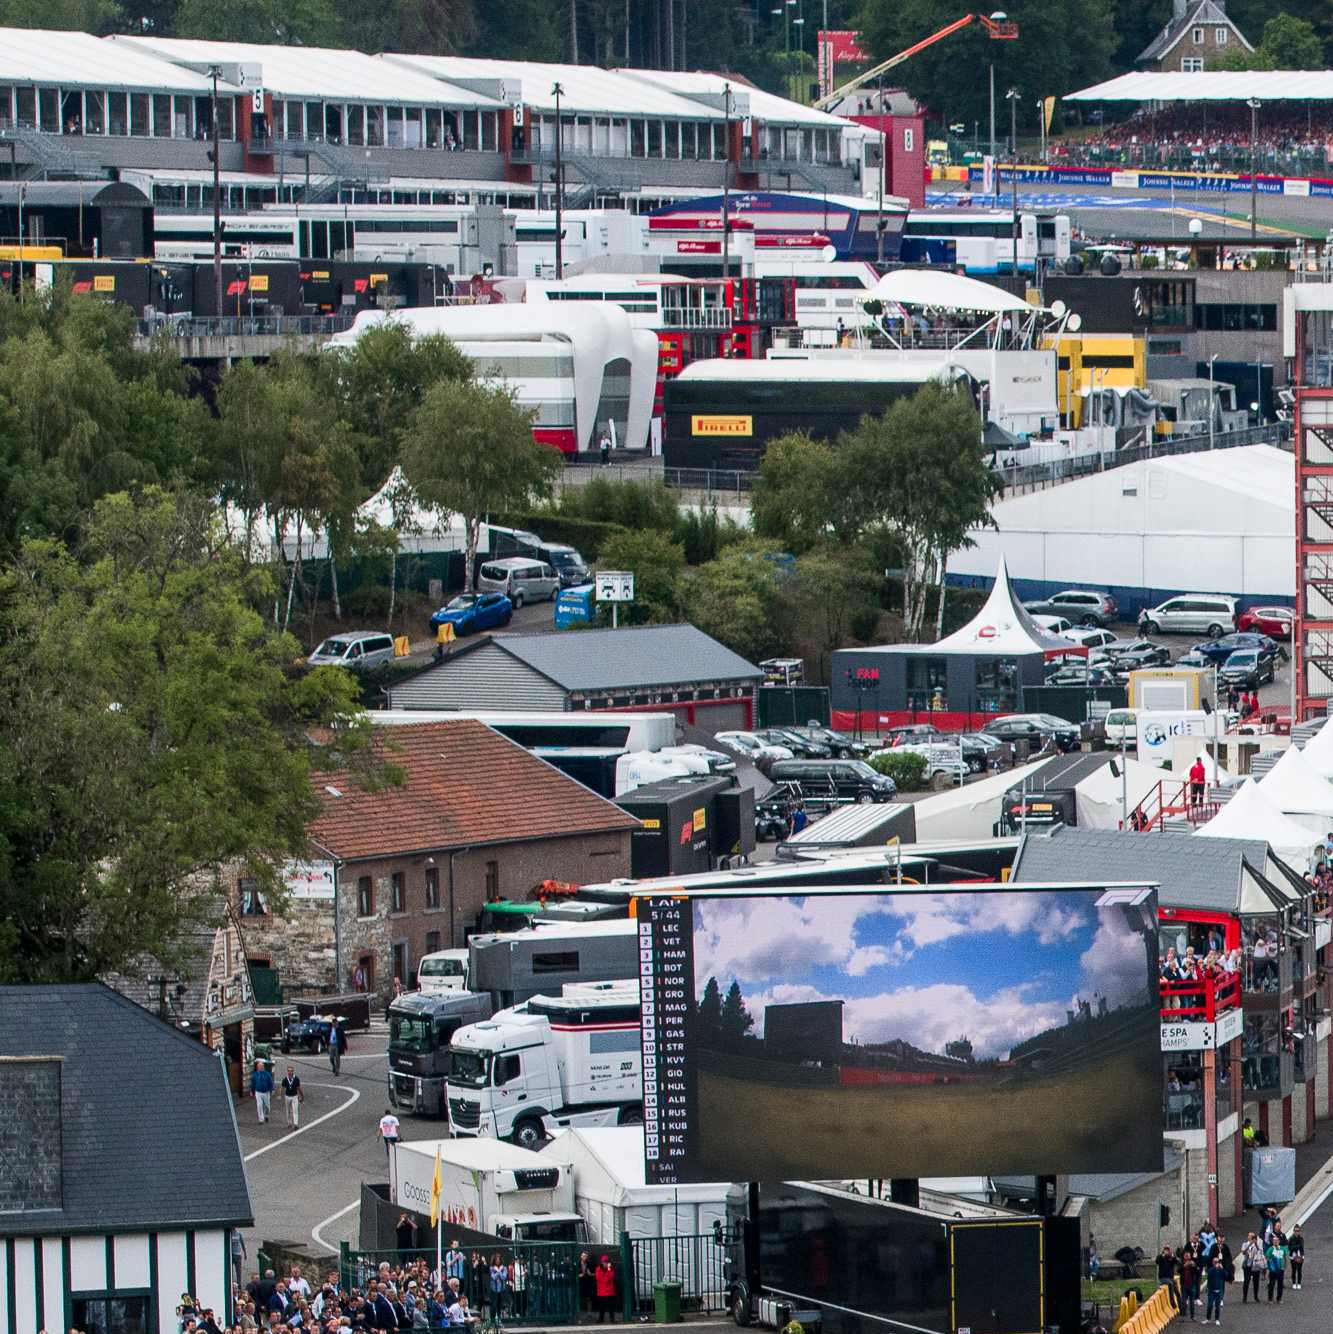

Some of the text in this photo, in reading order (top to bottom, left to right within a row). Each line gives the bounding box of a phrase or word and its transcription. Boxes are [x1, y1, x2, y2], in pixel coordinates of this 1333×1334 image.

[697, 419, 750, 433] PIRELLI
[663, 924, 679, 932] LEC
[663, 950, 686, 958] HAM
[664, 964, 682, 972] BOT
[664, 977, 685, 985] NOR
[665, 990, 684, 998] GRO
[665, 1003, 687, 1011] MAG
[666, 1017, 683, 1025] PER
[666, 1030, 685, 1038] GAS
[1169, 1028, 1188, 1037] SPA
[666, 1043, 684, 1051] STR
[667, 1056, 685, 1064] KVY
[667, 1069, 683, 1077] GIO
[669, 1122, 688, 1130] KUB
[670, 1135, 683, 1143] RIC
[670, 1148, 685, 1156] RAI
[659, 1163, 674, 1171] SAI
